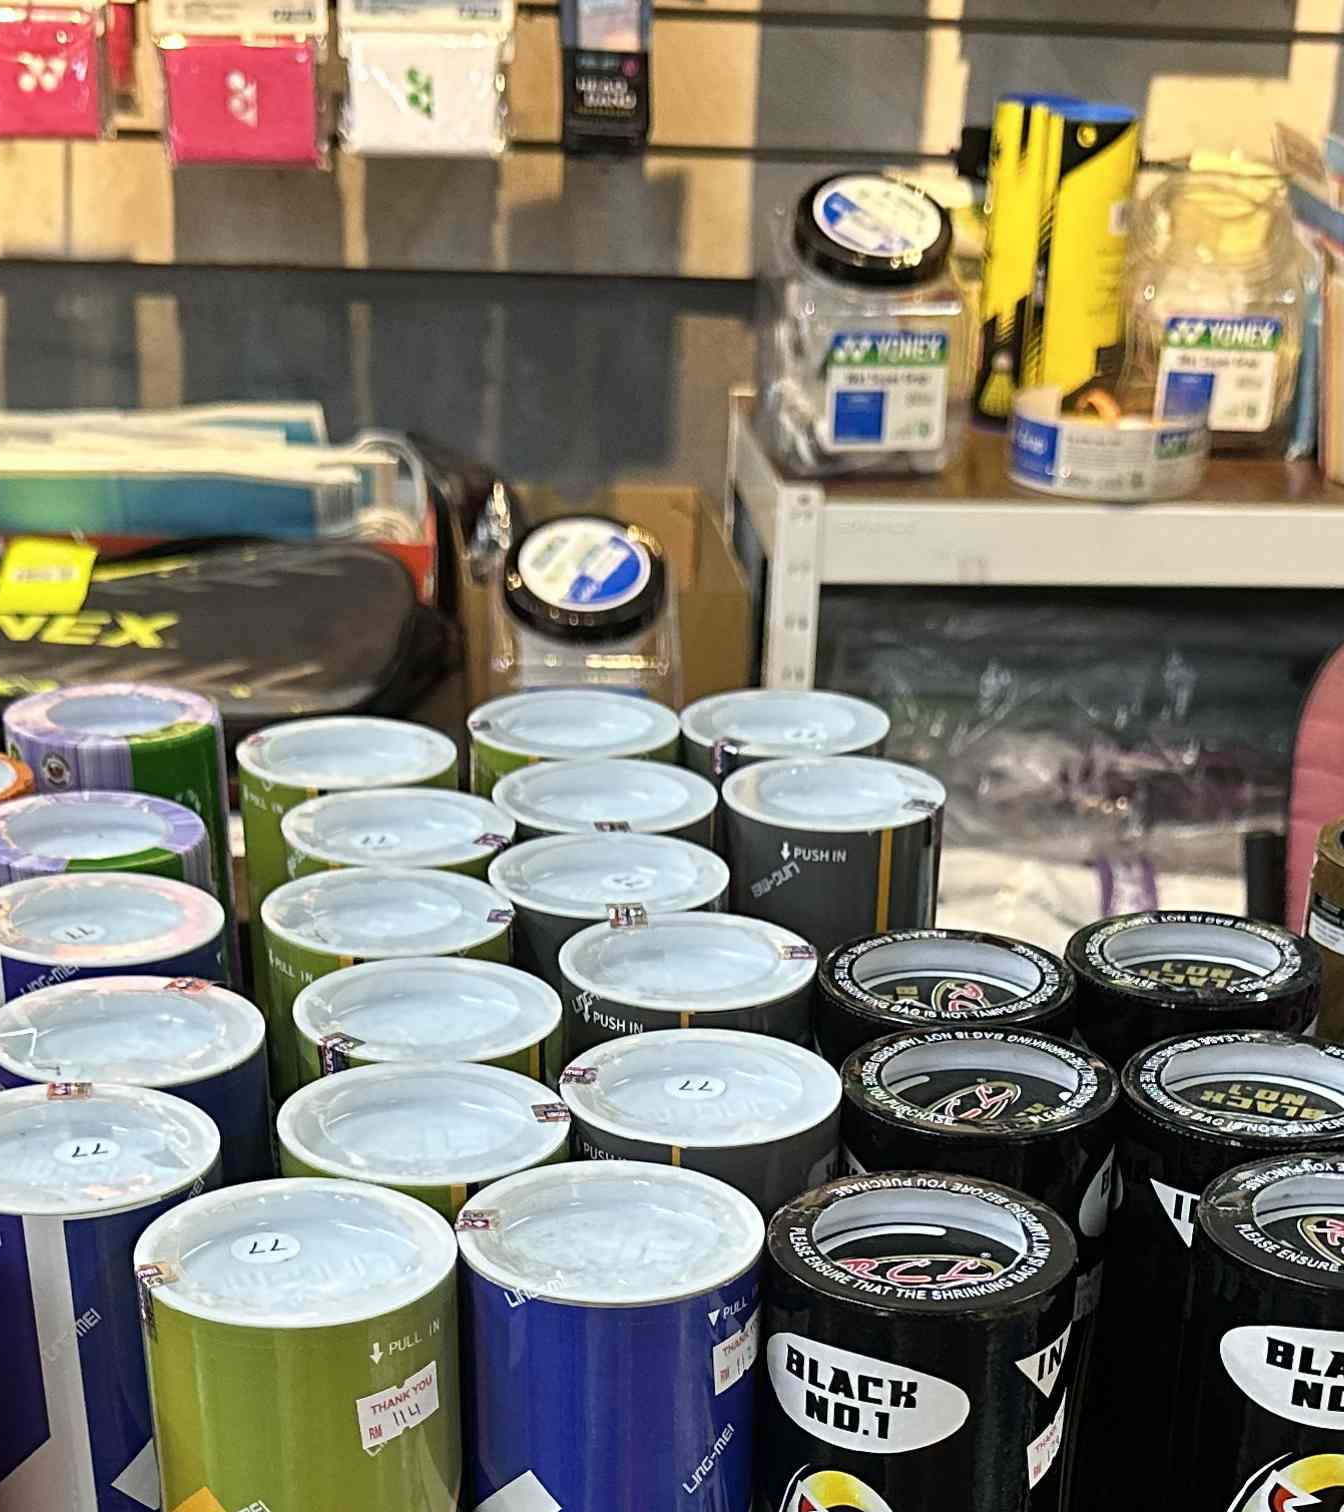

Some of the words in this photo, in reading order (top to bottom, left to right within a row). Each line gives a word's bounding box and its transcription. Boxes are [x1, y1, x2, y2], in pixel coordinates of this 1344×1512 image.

[793, 847, 828, 862] PUSH
[831, 848, 847, 862] IN
[592, 1011, 629, 1033] PUSH
[941, 1008, 970, 1020] NOT
[1200, 1091, 1329, 1120] BLACK
[1227, 1085, 1307, 1104] NO.1
[1304, 1159, 1336, 1175] YOU
[916, 1176, 948, 1190] YOU
[952, 1181, 1009, 1208] BEFORE
[789, 1226, 814, 1259] PLEASE
[1234, 1222, 1278, 1255] PLEASE
[806, 1249, 851, 1285] ENSURE
[1276, 1247, 1342, 1274] ENSURE
[852, 1277, 893, 1300] THAT
[931, 1273, 1014, 1301] SHRINKING
[1007, 1263, 1039, 1289] BAG
[895, 1288, 928, 1301] THE
[721, 1297, 749, 1321] PULL
[387, 1330, 424, 1356] PULL
[428, 1318, 442, 1338] IN
[1036, 1337, 1067, 1384] IN
[784, 1343, 919, 1410] BLACK
[369, 1388, 411, 1416] THANK
[411, 1374, 434, 1397] YOU
[804, 1390, 891, 1441] NO.1
[367, 1424, 384, 1442] RM
[680, 1423, 736, 1496] LING-MEI
